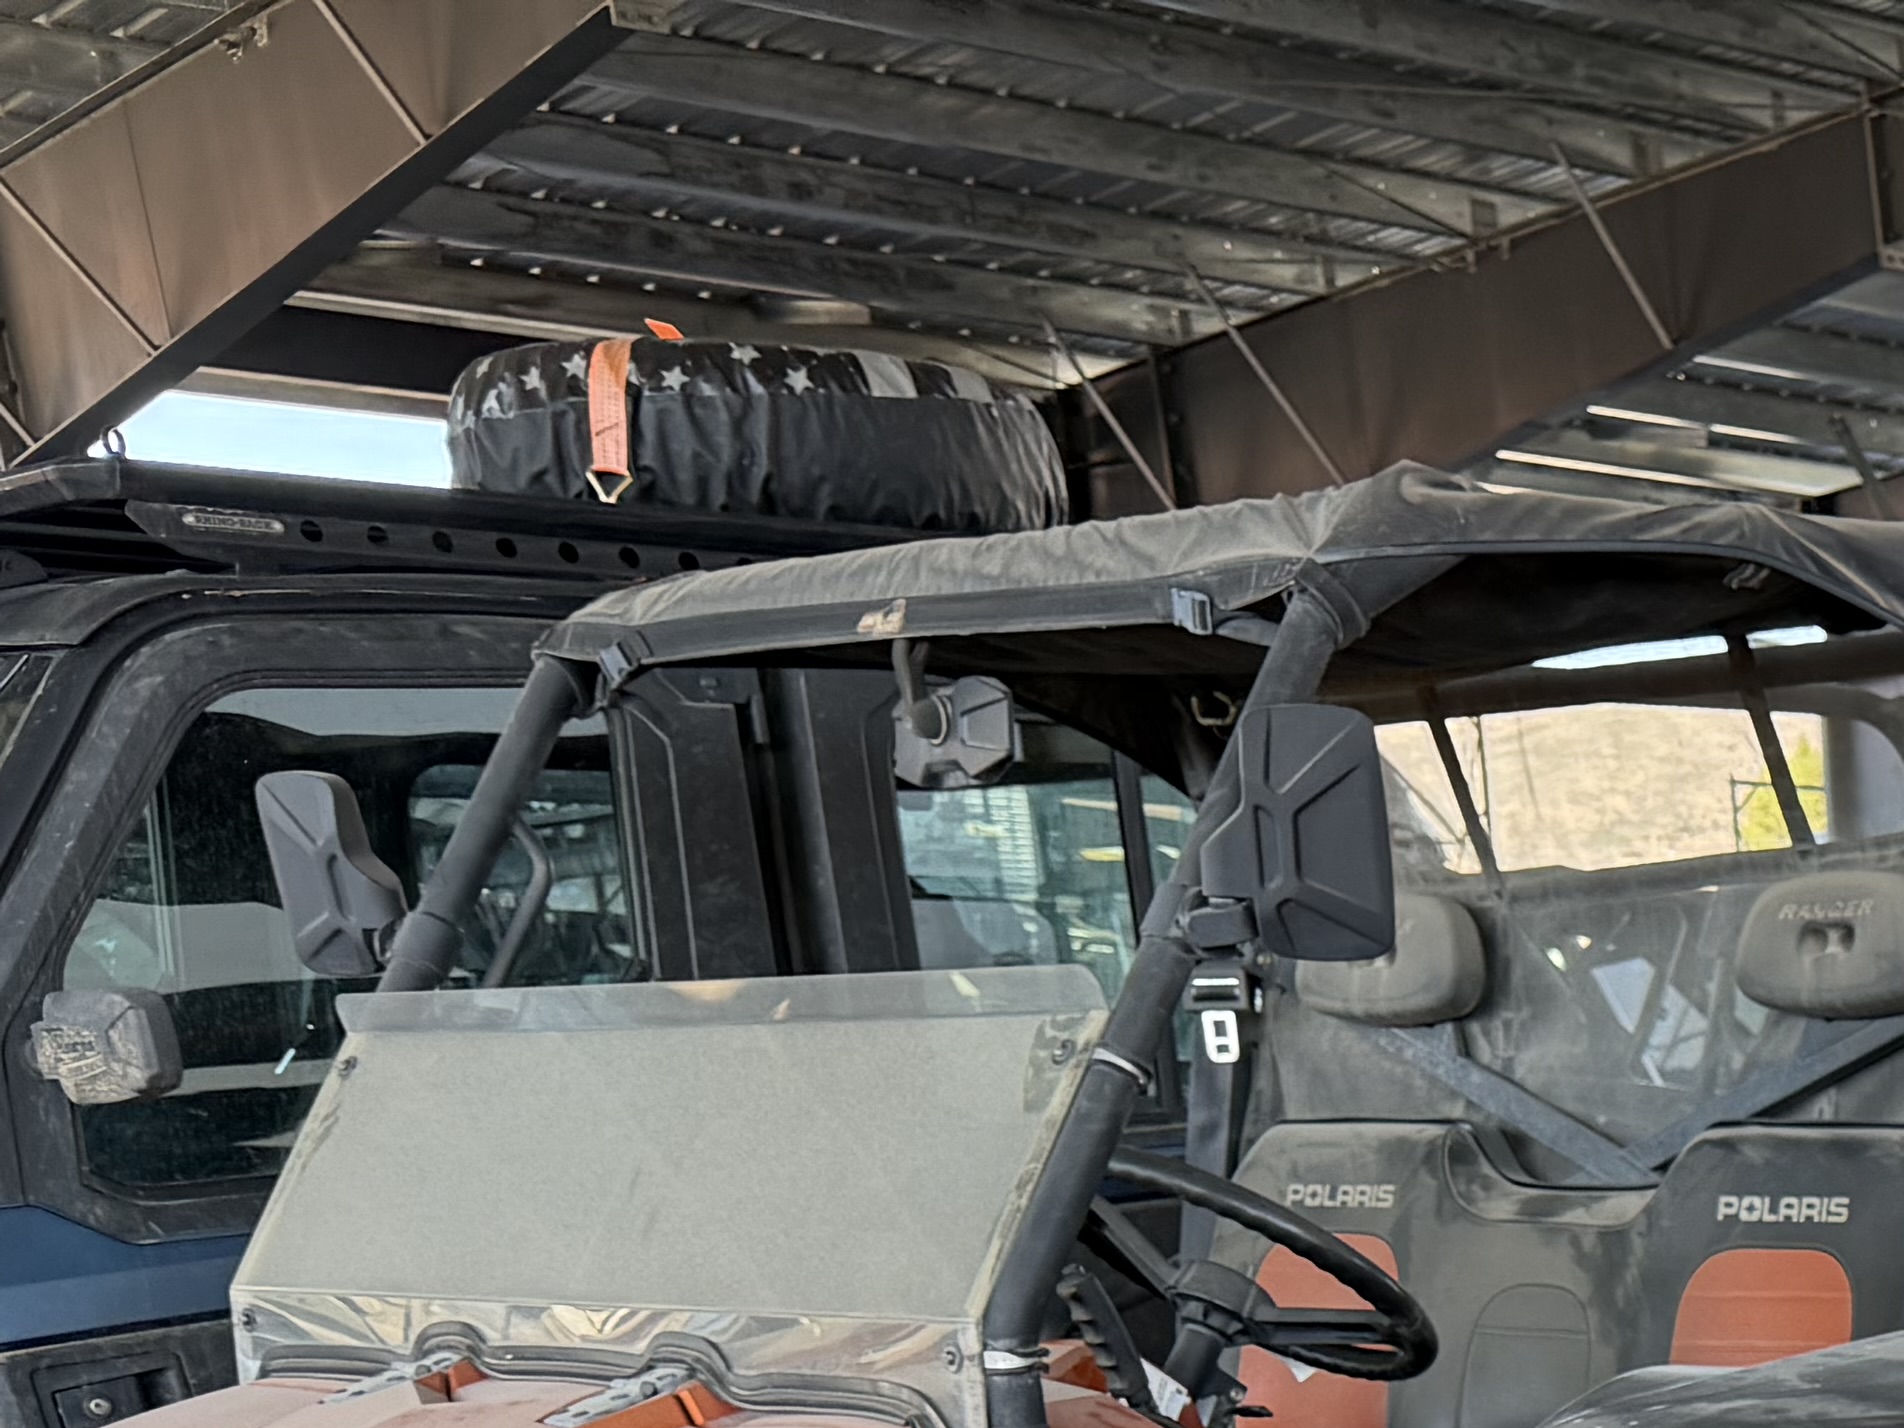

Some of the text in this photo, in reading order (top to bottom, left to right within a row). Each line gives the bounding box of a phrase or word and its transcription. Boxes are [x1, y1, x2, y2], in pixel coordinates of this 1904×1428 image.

[1777, 898, 1874, 920] RANGER
[1286, 1183, 1396, 1208] POLARIS
[1715, 1194, 1850, 1223] POLARIS
